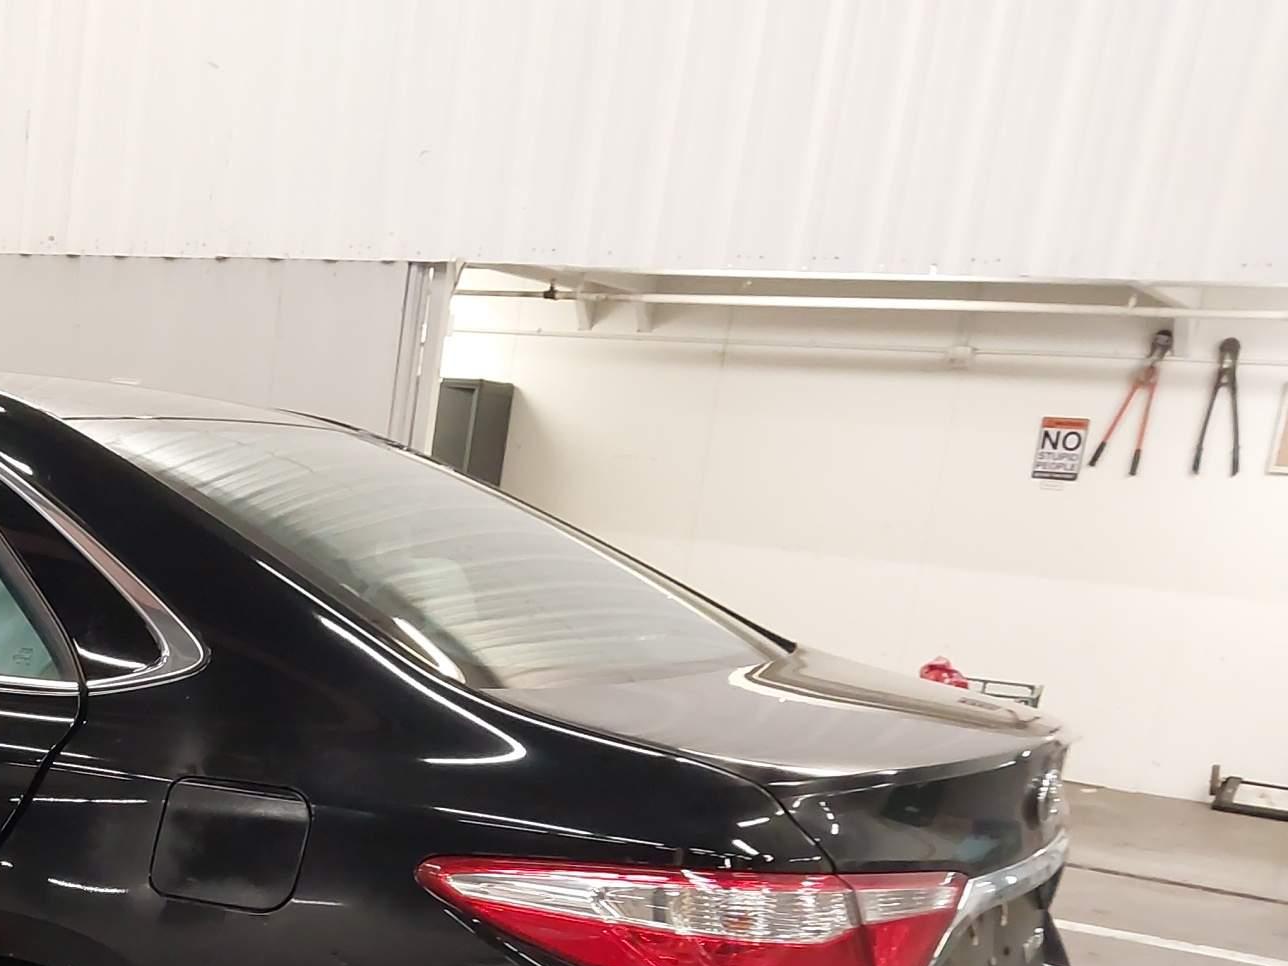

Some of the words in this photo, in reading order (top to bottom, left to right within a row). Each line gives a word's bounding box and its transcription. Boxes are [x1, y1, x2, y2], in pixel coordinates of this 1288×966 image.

[1041, 430, 1082, 451] NO
[1037, 451, 1080, 462] STUPID
[1035, 461, 1076, 472] PEOPLE
